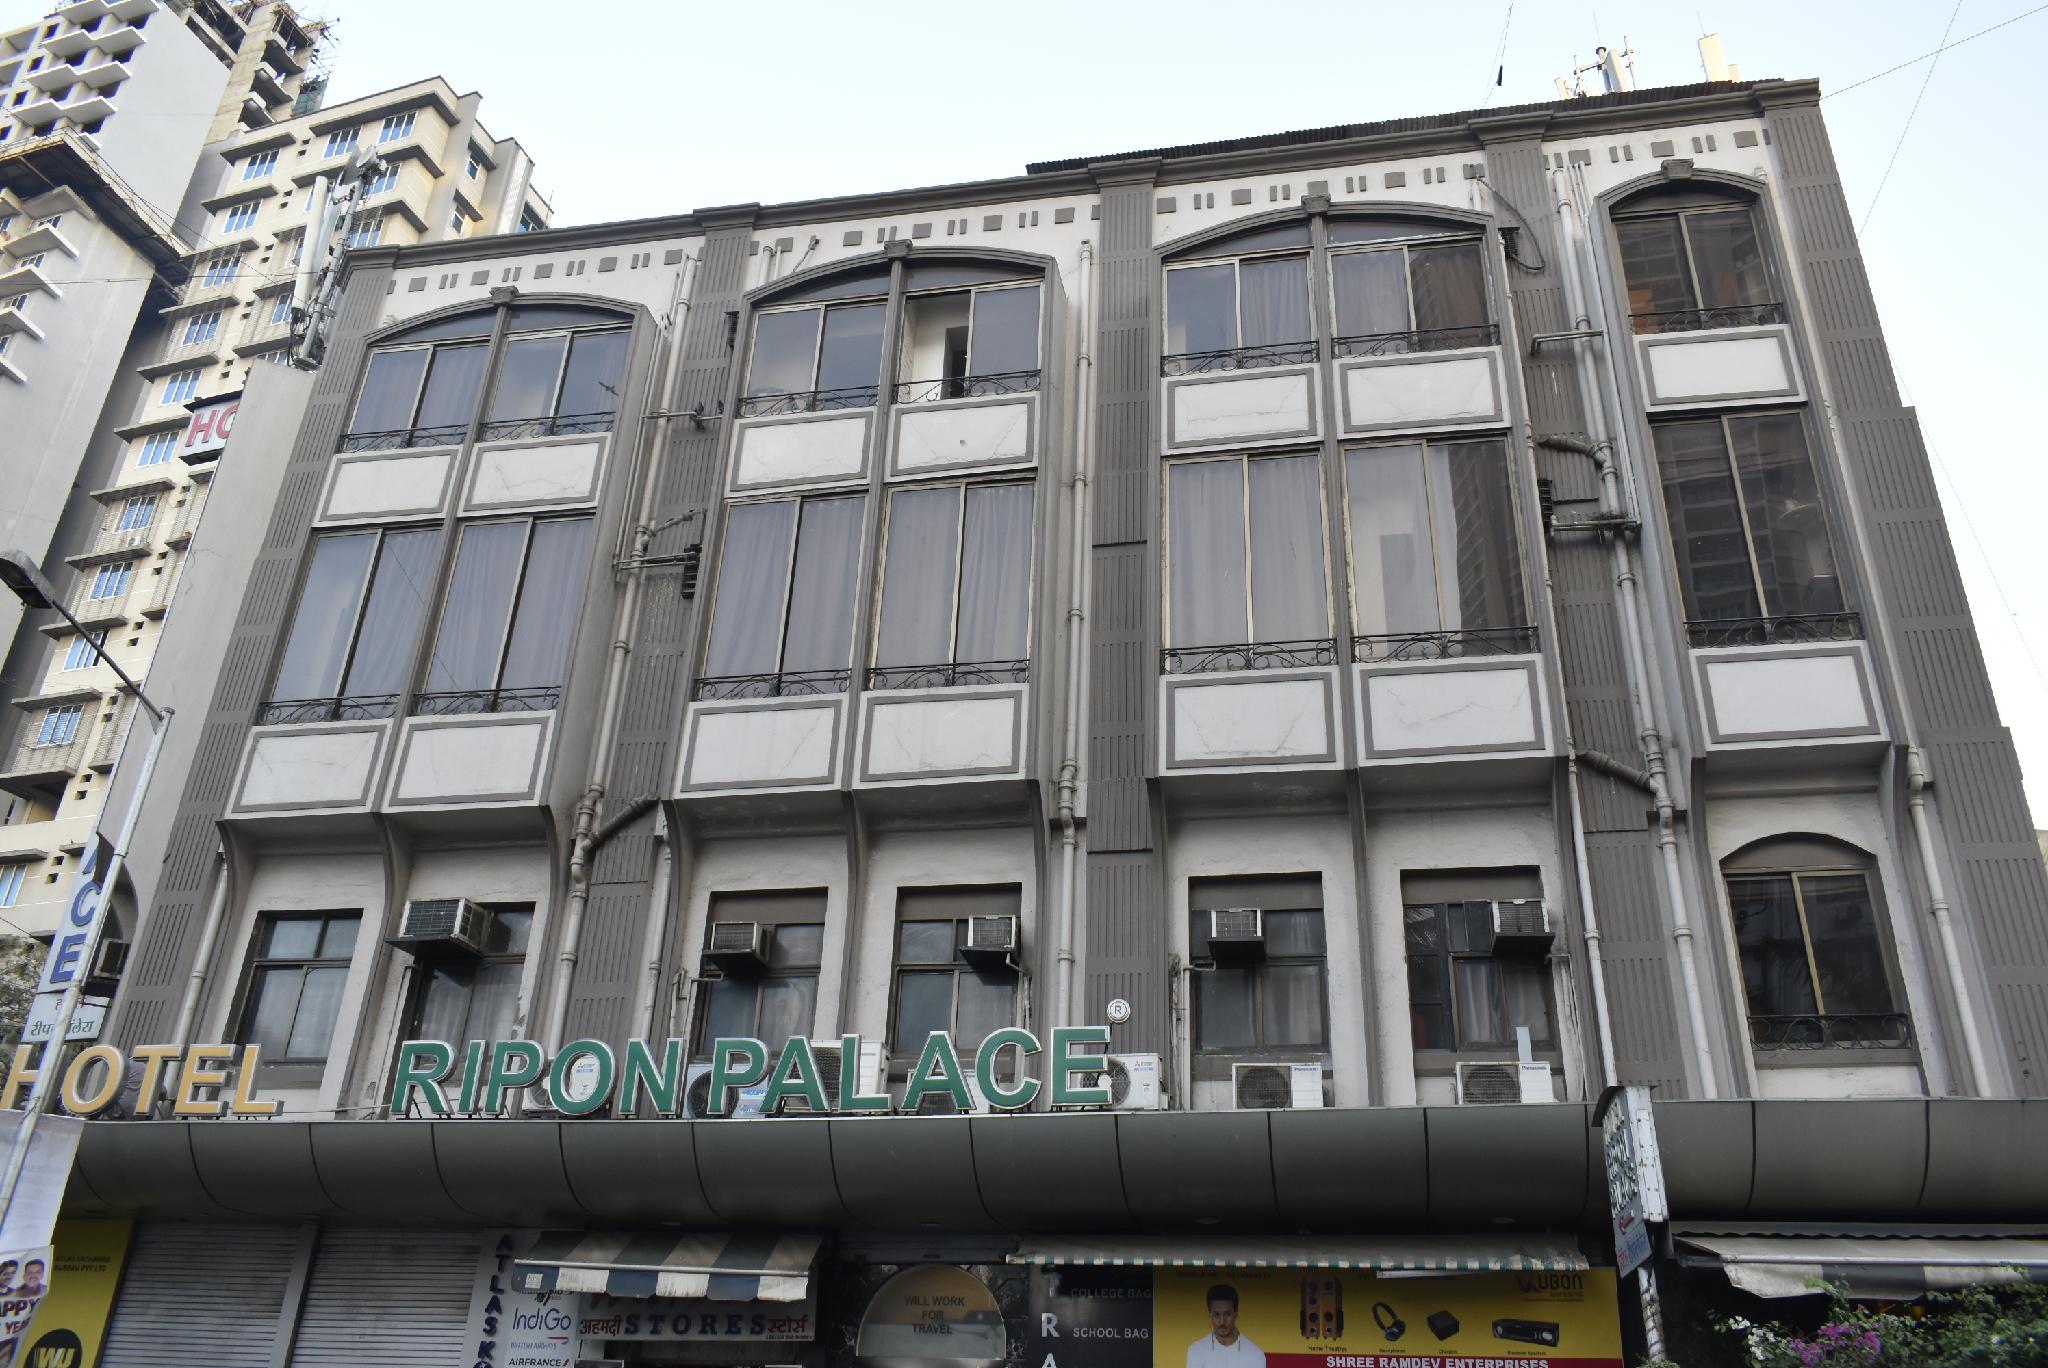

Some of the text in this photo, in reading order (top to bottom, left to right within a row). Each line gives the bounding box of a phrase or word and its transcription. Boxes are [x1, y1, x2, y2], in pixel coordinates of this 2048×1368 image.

[0, 1043, 284, 1118] HOTEL
[390, 1038, 684, 1115] RIPON
[706, 1026, 1113, 1115] PALACE
[1071, 1287, 1152, 1299] COLLEGE BAG
[905, 1296, 965, 1307] WILL WORK
[512, 1307, 571, 1331] IndiGo
[922, 1310, 944, 1320] FOR
[579, 1314, 623, 1337] अहमदी
[624, 1313, 767, 1335] STORES
[912, 1323, 953, 1335] TRAVEL
[1073, 1327, 1150, 1340] SCHOOL BAG
[508, 1357, 562, 1367] AIRFRANCE
[1326, 1356, 1550, 1368] SHREE RAMDEV ENTERPRISES
